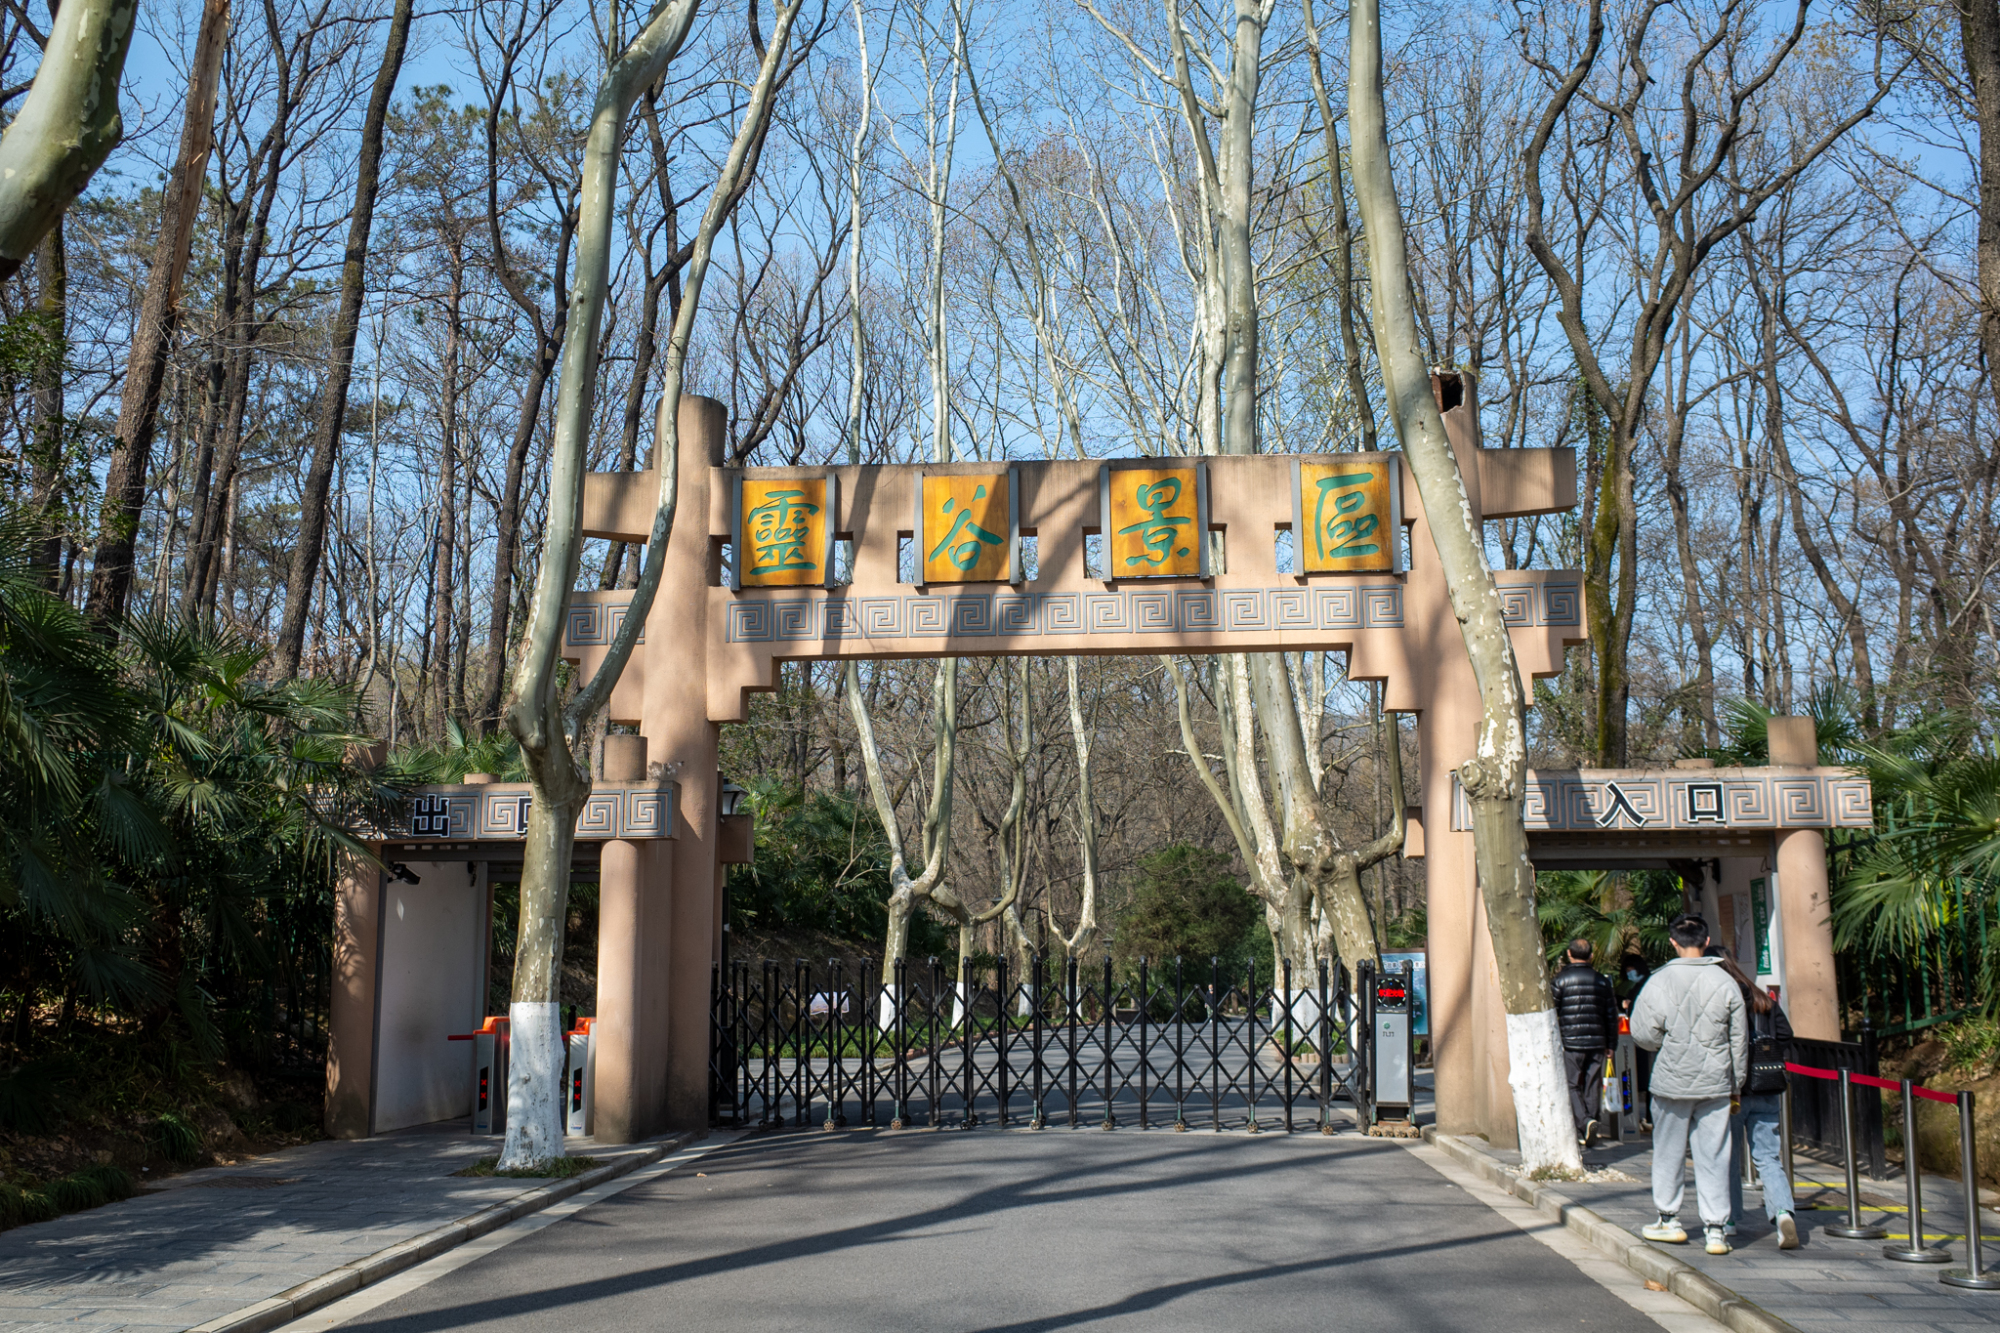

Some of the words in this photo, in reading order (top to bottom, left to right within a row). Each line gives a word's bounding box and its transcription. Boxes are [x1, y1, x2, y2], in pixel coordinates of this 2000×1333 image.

[748, 472, 1379, 575] 靈谷景區
[1596, 780, 1726, 828] 入口
